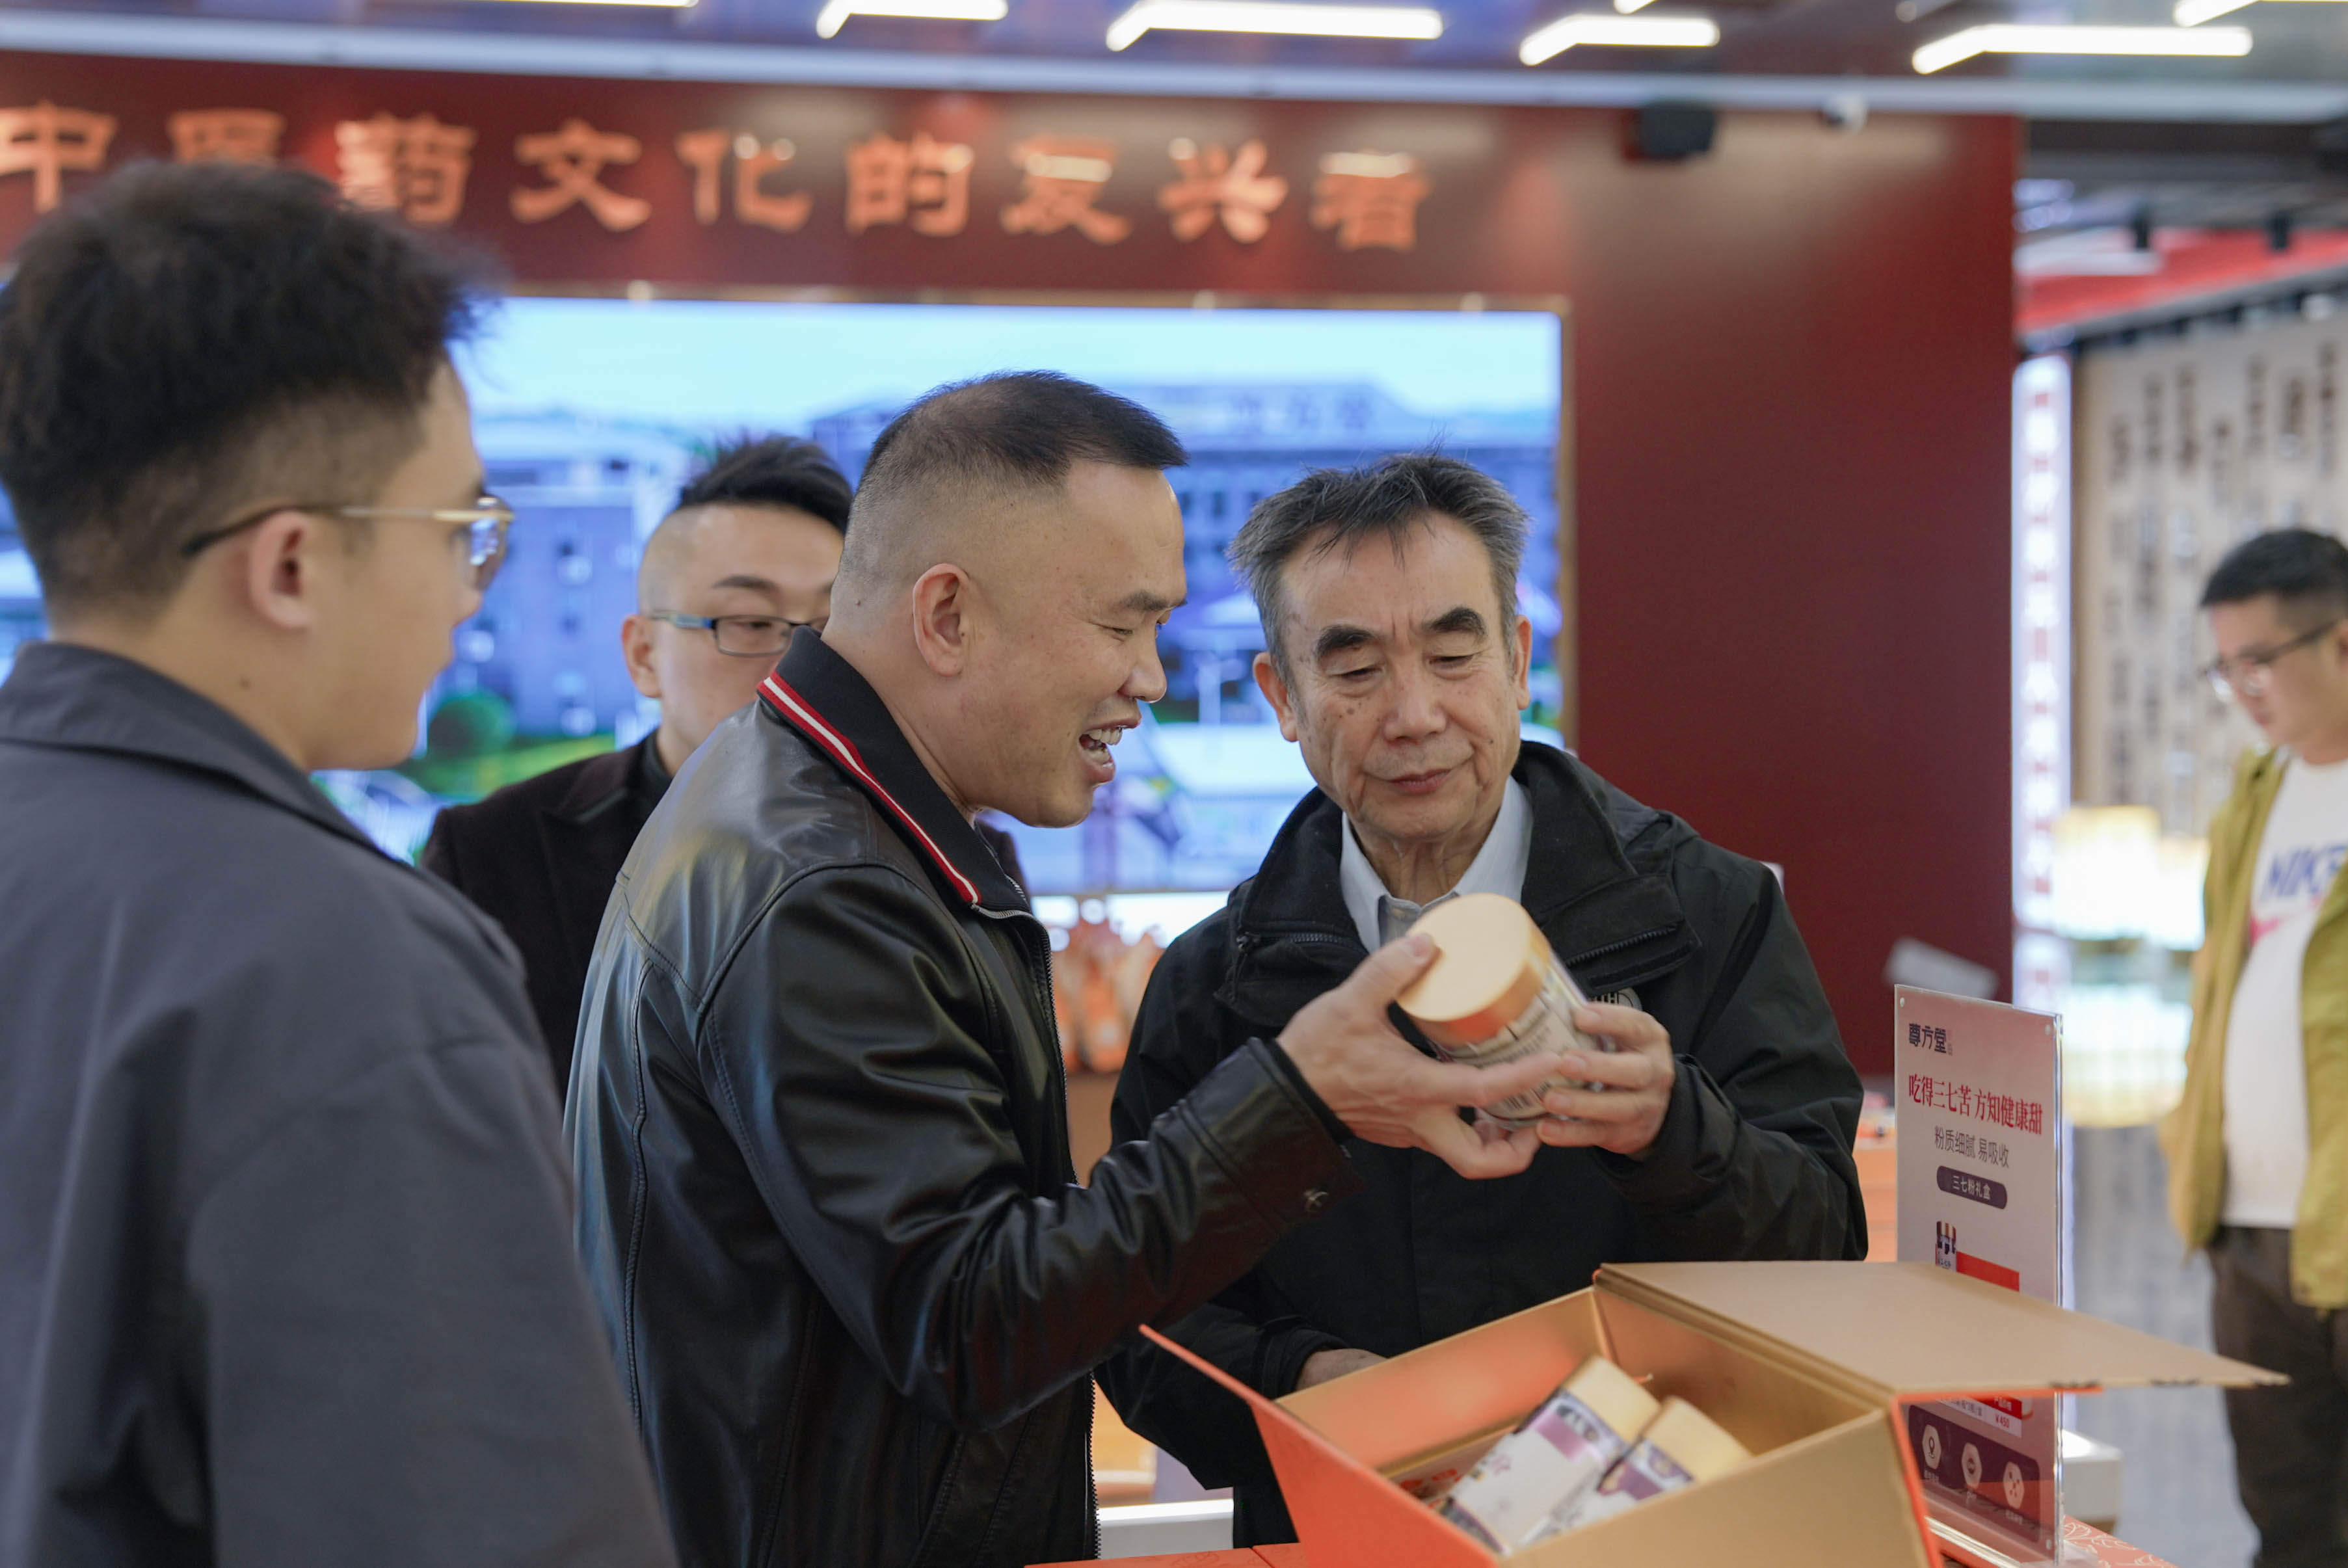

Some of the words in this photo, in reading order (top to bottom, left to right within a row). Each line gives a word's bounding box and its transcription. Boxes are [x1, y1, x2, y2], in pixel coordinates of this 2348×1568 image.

[1908, 1074, 1972, 1117] 吃得三七苦
[1974, 1088, 2043, 1135] 方知健康甜
[1934, 1125, 1976, 1158] 粉质细腻
[1978, 1138, 2009, 1168] 易吸收
[1953, 1175, 1991, 1200] 三七粉礼盒
